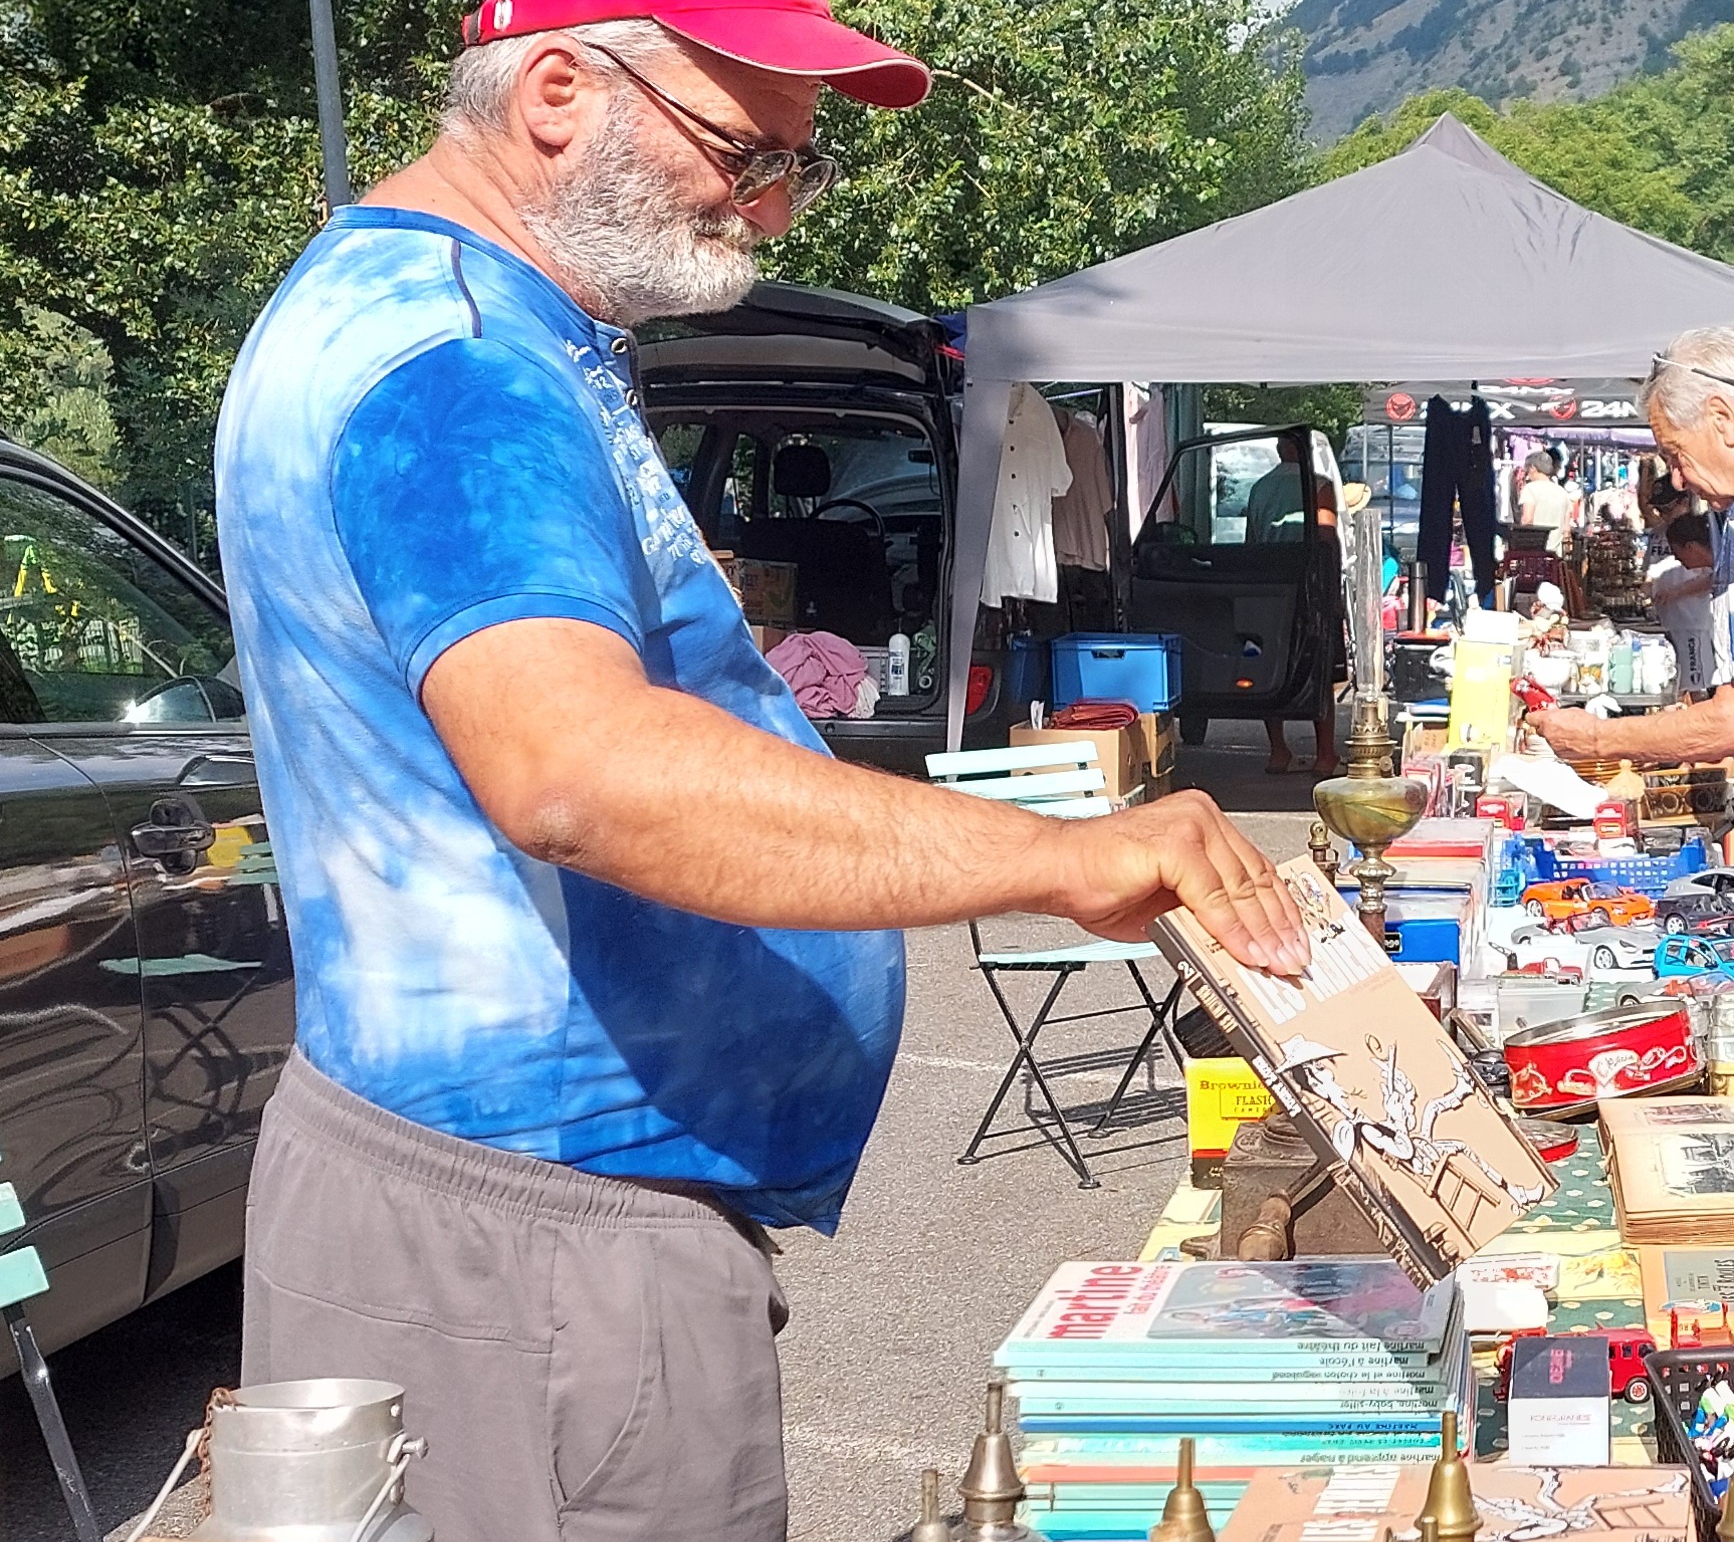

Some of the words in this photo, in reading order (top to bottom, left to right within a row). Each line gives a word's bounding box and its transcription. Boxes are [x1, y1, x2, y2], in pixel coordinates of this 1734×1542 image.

[1651, 545, 1672, 556] FRA
[1177, 961, 1196, 980] 2
[1236, 1096, 1271, 1105] FLASH
[1048, 1265, 1143, 1339] martine
[1344, 1342, 1358, 1353] du
[1361, 1341, 1381, 1353] fait
[1384, 1341, 1424, 1352] martine
[1368, 1356, 1408, 1366] martine
[1386, 1371, 1425, 1380] martine
[1401, 1454, 1440, 1464] martine
